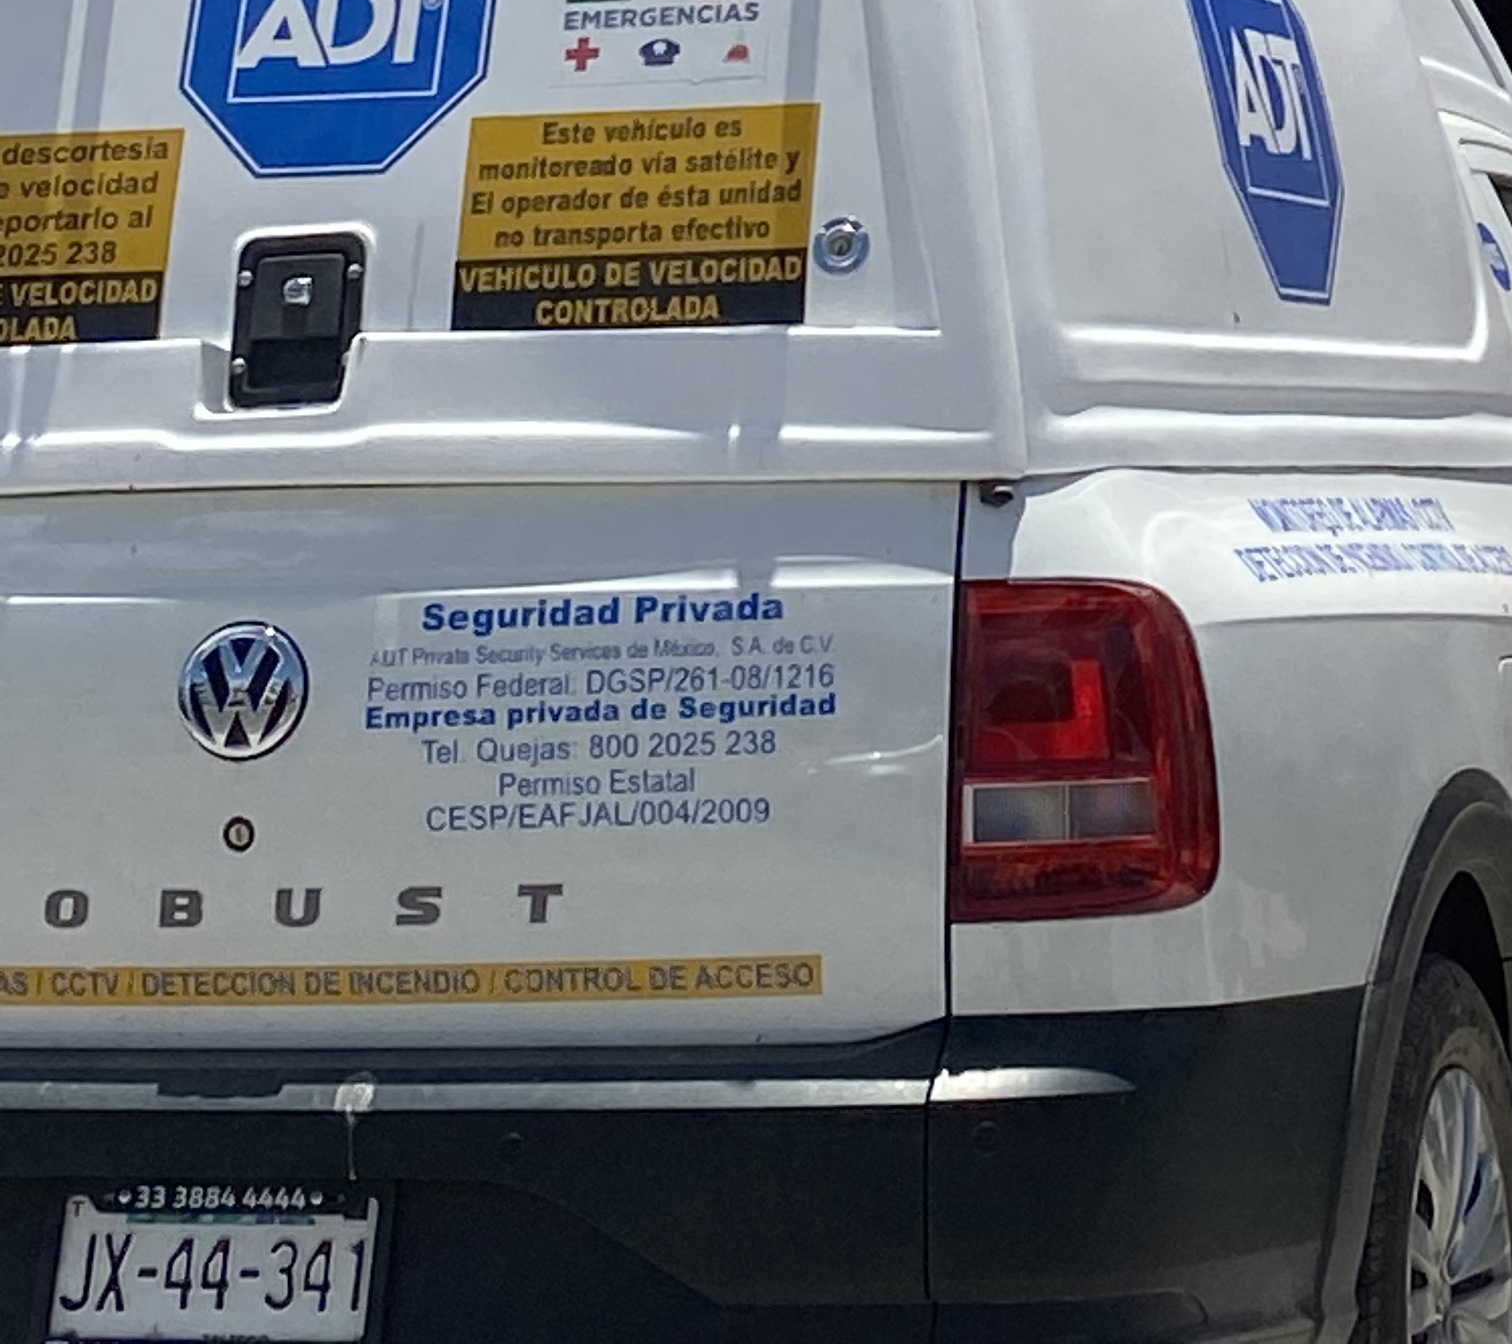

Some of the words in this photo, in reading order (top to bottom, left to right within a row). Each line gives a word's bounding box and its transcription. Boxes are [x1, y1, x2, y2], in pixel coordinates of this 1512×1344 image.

[563, 2, 760, 31] EMERGENCIAS
[1231, 26, 1313, 161] ADT
[542, 121, 595, 145] Este
[715, 118, 742, 139] es
[478, 154, 633, 181] monitoreado
[685, 147, 779, 172] satélite
[785, 150, 801, 176] y
[20, 170, 160, 198] velocidad
[470, 191, 494, 215] El
[501, 187, 612, 218] operador
[620, 185, 648, 209] de
[719, 179, 803, 205] unidad
[128, 204, 154, 229] al
[494, 228, 525, 249] no
[533, 221, 662, 250] transporta
[671, 216, 770, 241] efectivo
[66, 240, 117, 265] 238
[604, 262, 640, 288] DE
[650, 256, 803, 286] VELOCIDAD
[11, 279, 158, 308] VELOCIDAD
[535, 294, 722, 326] CONTROLADA
[422, 597, 620, 637] Seguridad
[635, 592, 784, 624] Privada
[475, 643, 545, 666] Security
[550, 640, 622, 662] Services
[627, 642, 648, 659] de
[368, 674, 468, 702] Permiso
[587, 663, 834, 695] DGSP/261-08/1216
[366, 706, 497, 734] Empresa
[507, 699, 620, 730] privada
[630, 697, 667, 721] de
[679, 692, 837, 724] Seguridad
[590, 733, 639, 759] 800
[648, 731, 716, 758] 2025
[725, 729, 777, 756] 238
[499, 771, 601, 798] Permiso
[610, 766, 696, 795] Estatal
[50, 971, 121, 997] CCTV
[141, 970, 296, 997] DETECCION
[304, 969, 342, 996] DE
[349, 967, 481, 995] INCENDIO
[504, 966, 642, 994] CONTROL
[649, 965, 688, 991] DE
[695, 962, 814, 990] ACCESO
[135, 1185, 166, 1209] 33
[172, 1185, 236, 1210] 3884
[242, 1185, 307, 1210] 4444
[59, 1232, 366, 1313] JX-44-341
